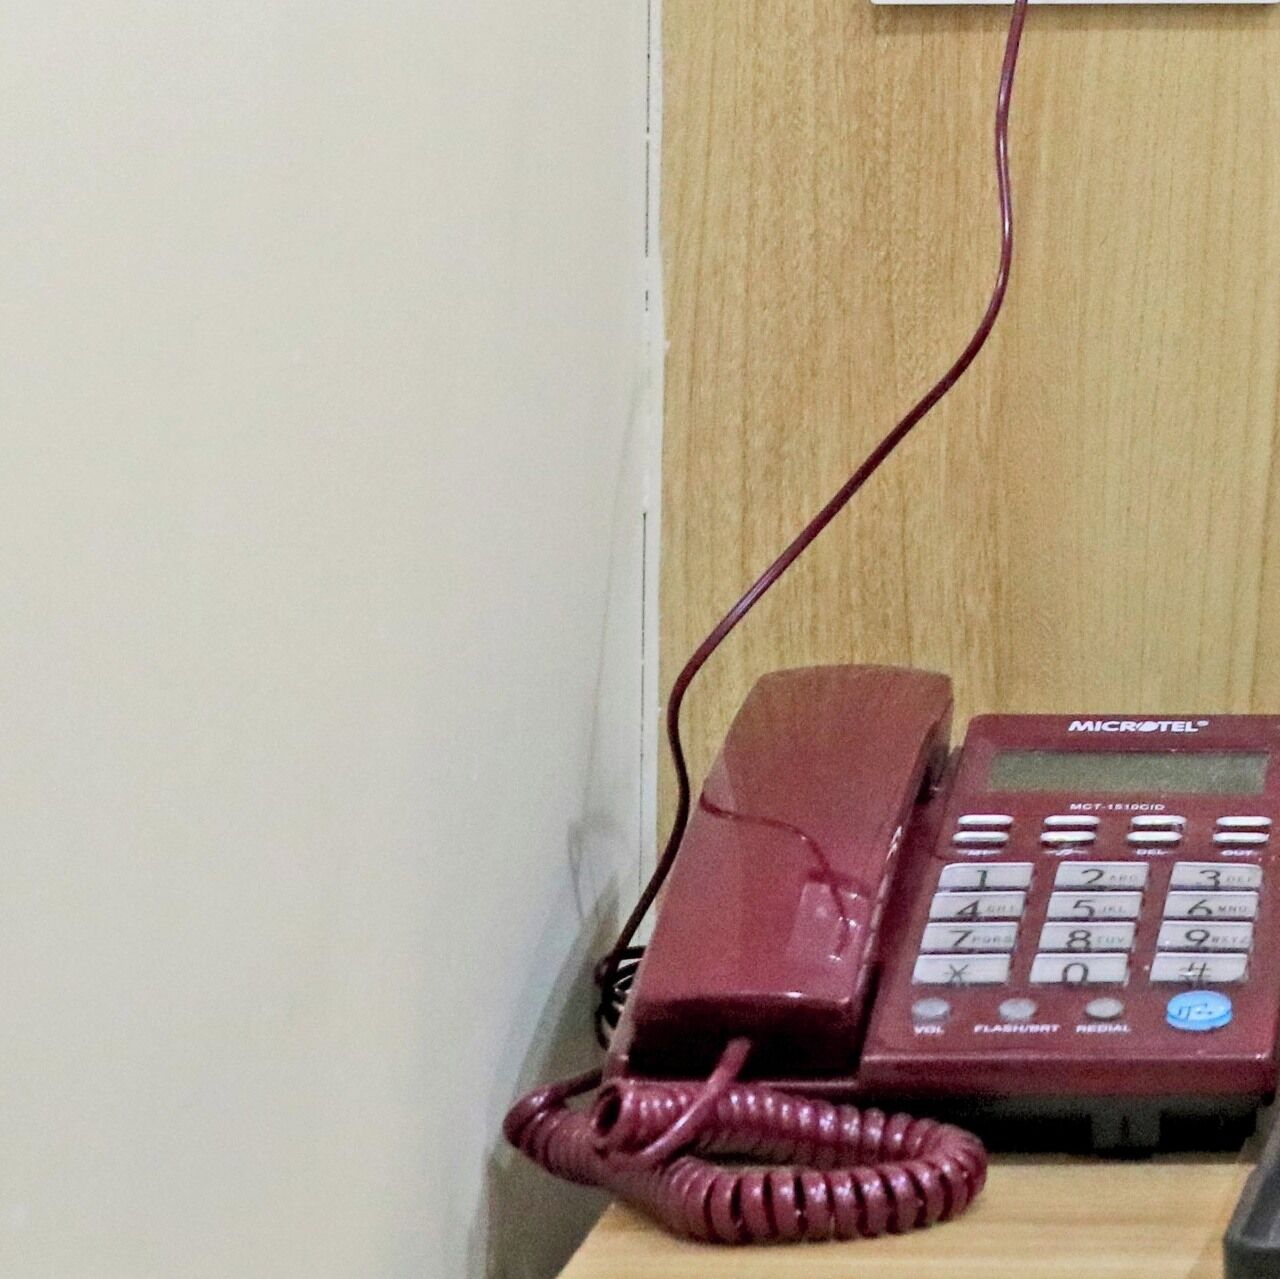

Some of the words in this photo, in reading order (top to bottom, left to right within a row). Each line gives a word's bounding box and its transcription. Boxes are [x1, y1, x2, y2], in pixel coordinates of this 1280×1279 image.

[977, 870, 988, 888] 1
[1081, 869, 1105, 887] 2
[1199, 869, 1221, 887] 3
[957, 900, 982, 917] 4
[1072, 900, 1096, 917] 5
[1187, 899, 1213, 916] 6
[949, 929, 974, 946] 7
[1065, 929, 1092, 950] 8
[1185, 929, 1210, 947] 9
[1062, 962, 1089, 984] 0
